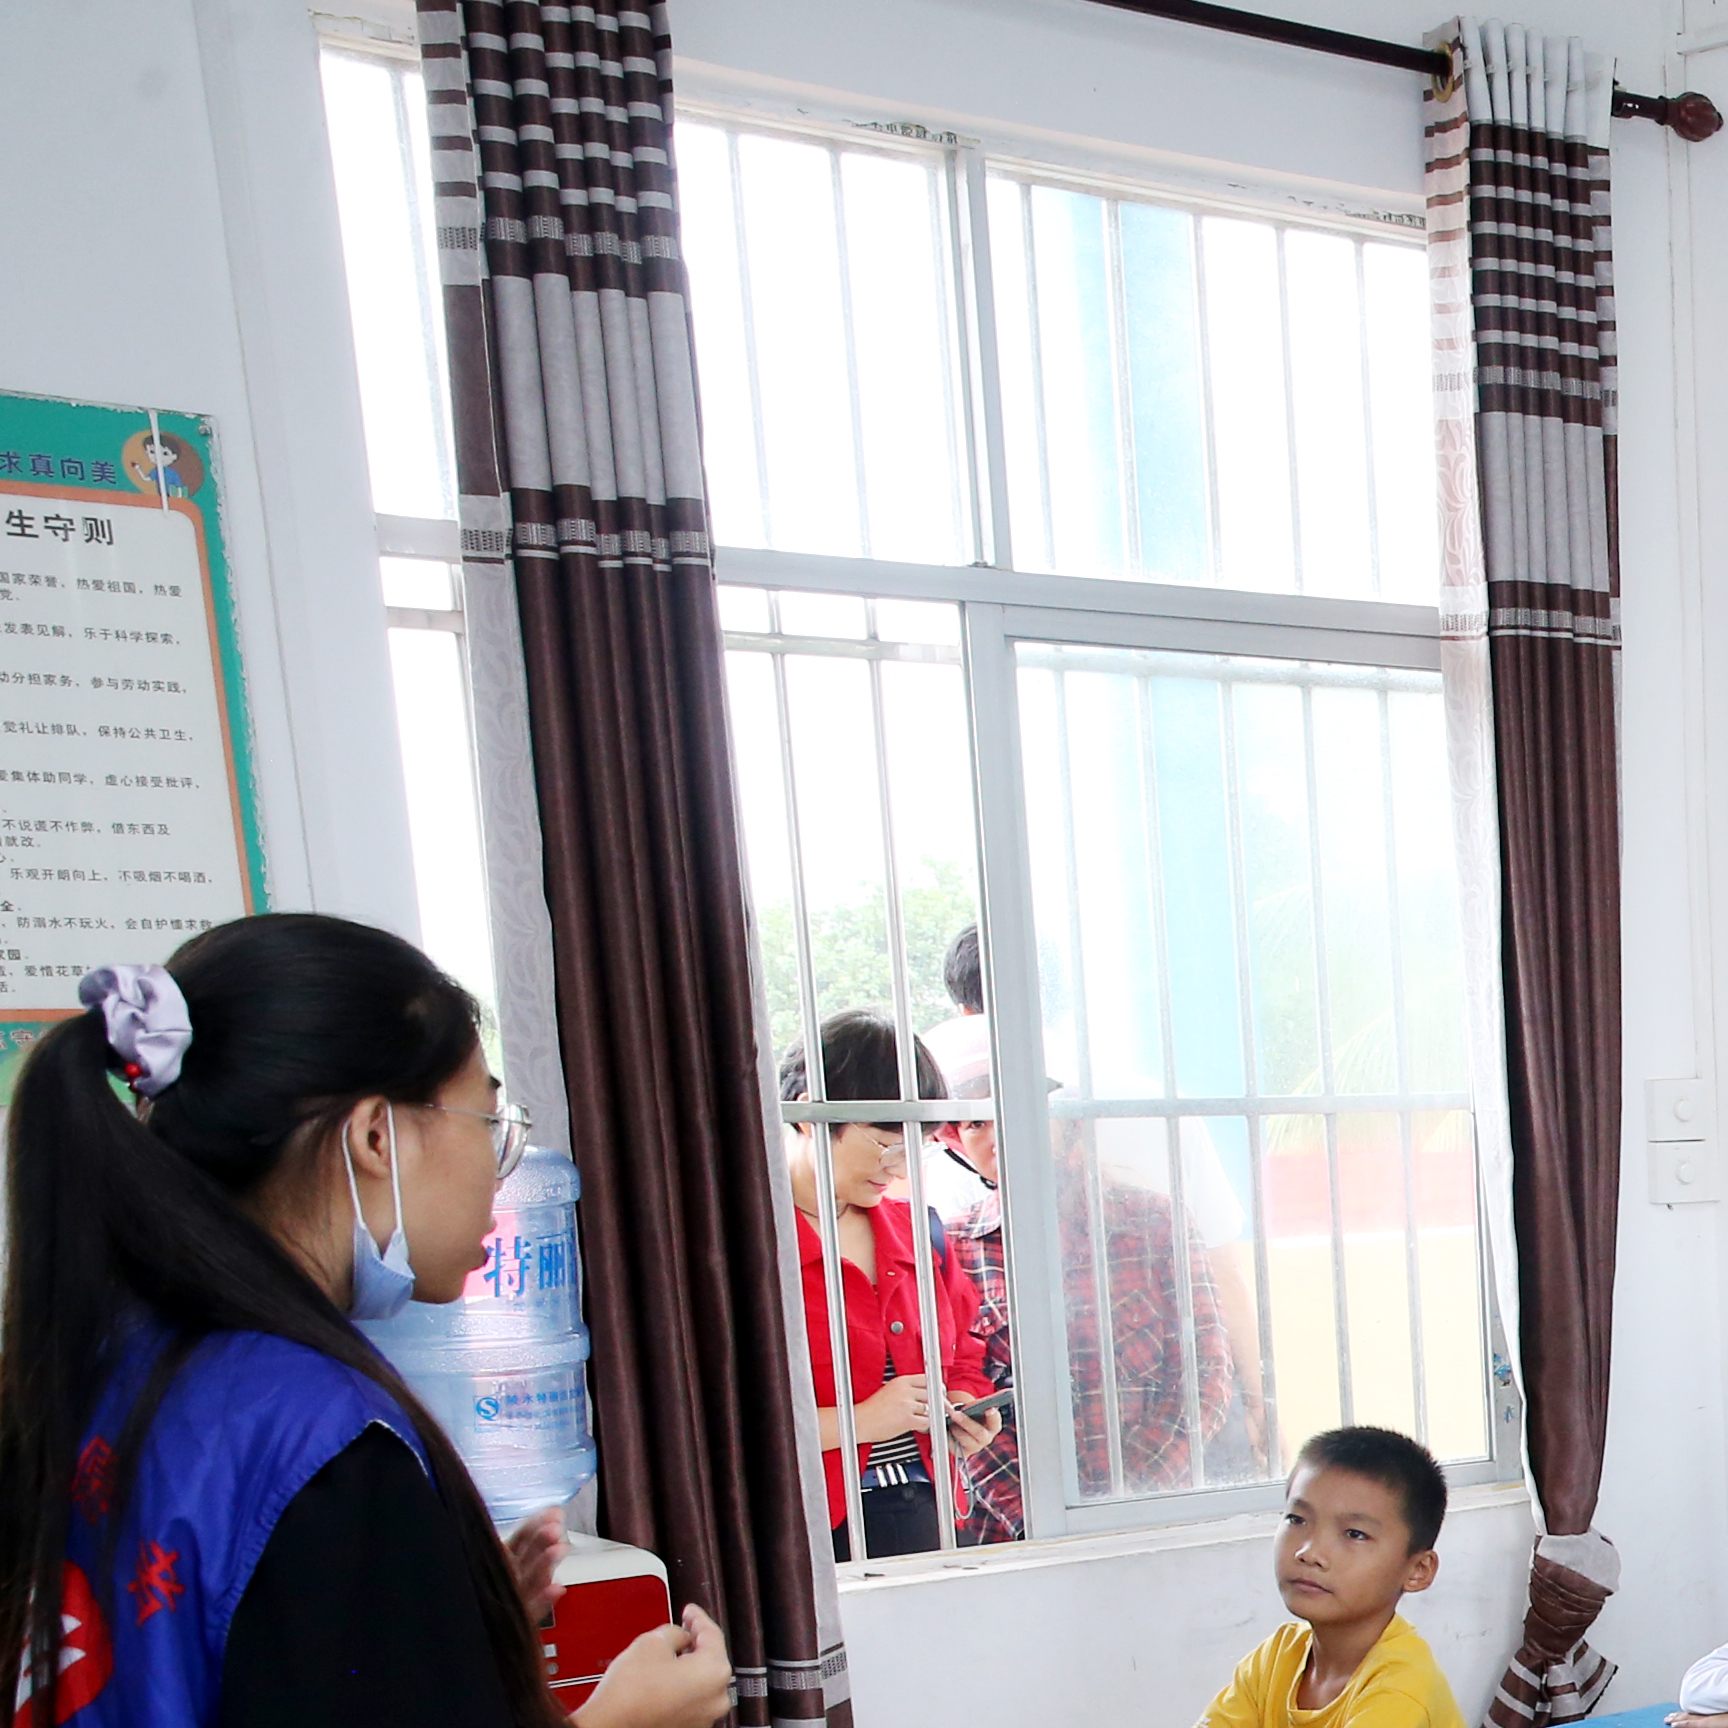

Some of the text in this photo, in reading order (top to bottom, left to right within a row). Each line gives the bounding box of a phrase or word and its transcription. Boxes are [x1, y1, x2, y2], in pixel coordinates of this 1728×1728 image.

[0, 451, 118, 485] 求真向美
[5, 509, 115, 546] 生守则
